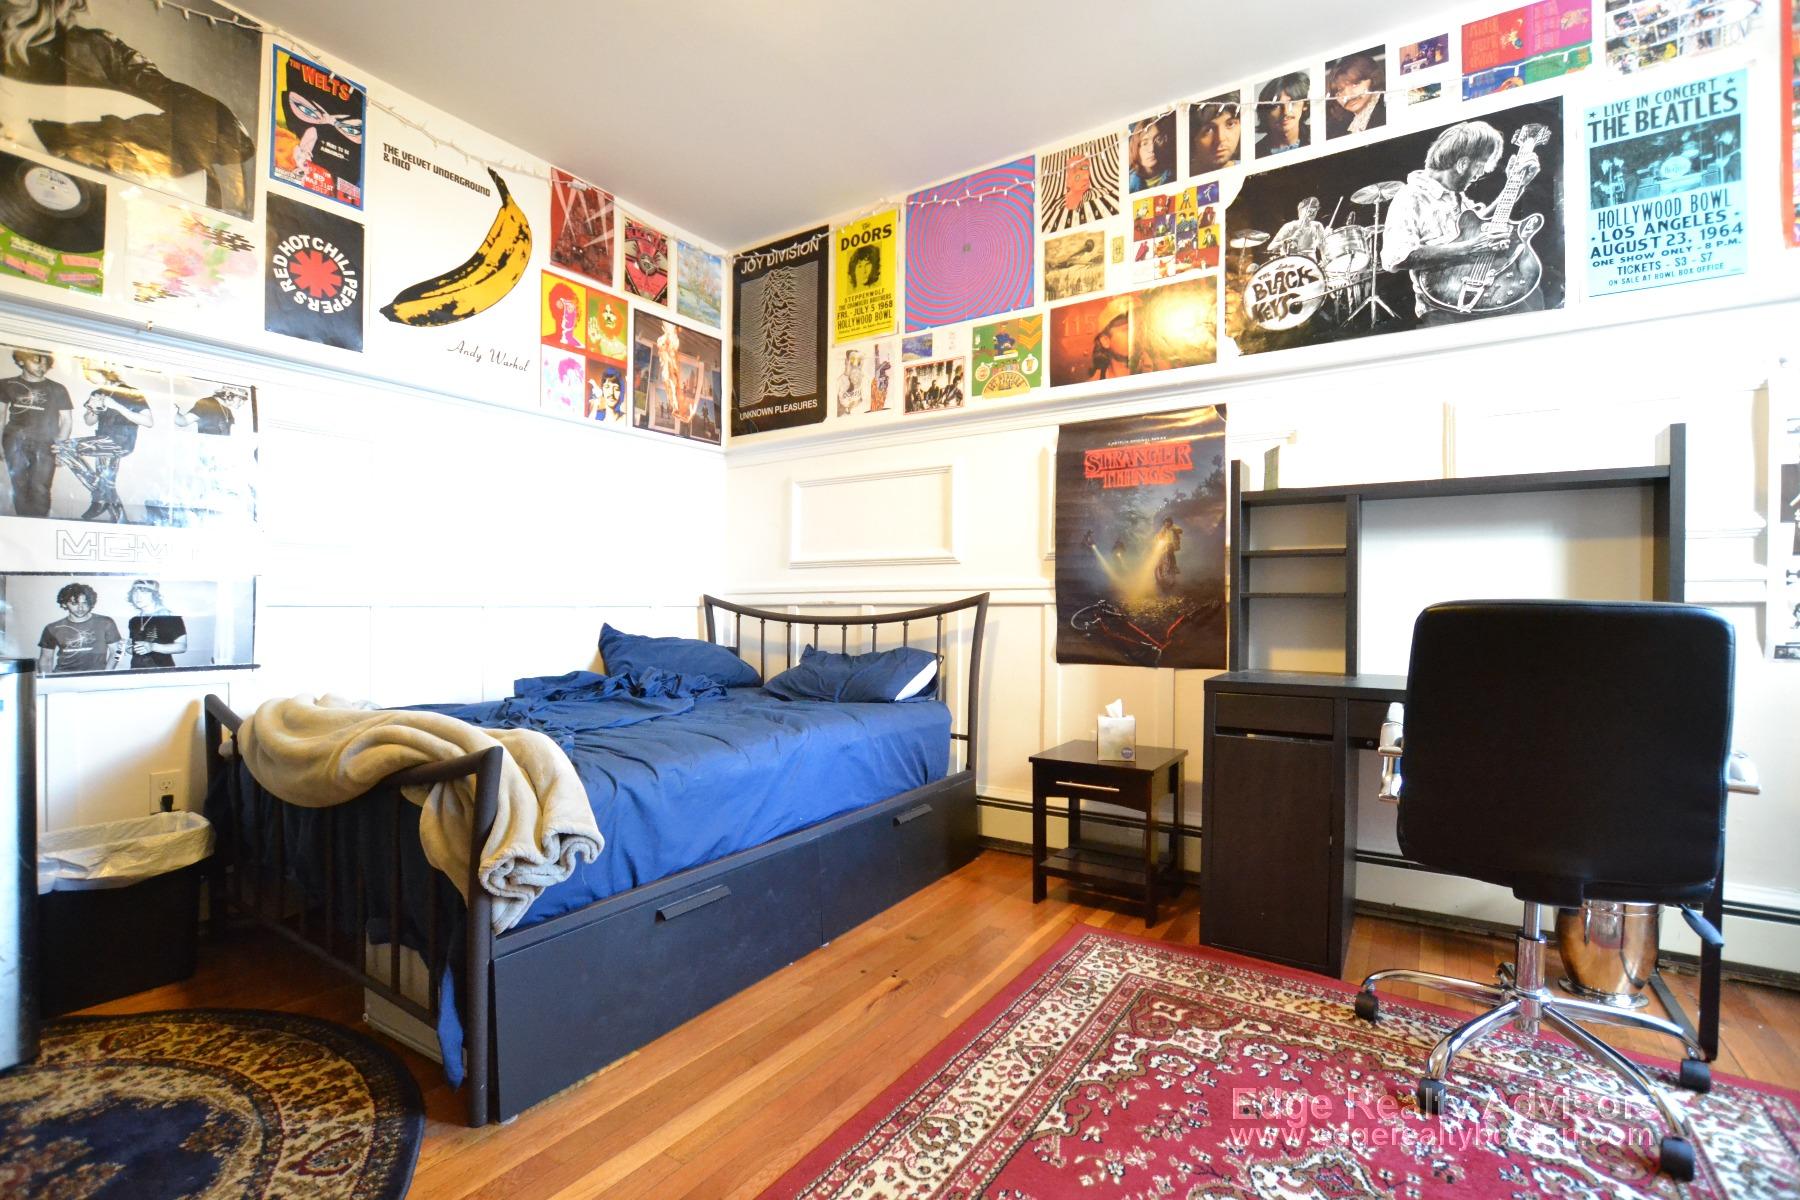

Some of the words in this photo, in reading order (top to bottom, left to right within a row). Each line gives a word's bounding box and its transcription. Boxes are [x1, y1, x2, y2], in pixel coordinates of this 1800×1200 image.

[301, 63, 351, 101] WELTS
[1603, 99, 1631, 117] LIVE
[1636, 95, 1649, 109] IN
[1655, 78, 1717, 104] CONCERT
[1587, 113, 1630, 143] THE
[1634, 87, 1738, 133] BEATLES
[383, 152, 390, 162] &
[391, 156, 411, 171] NICO
[383, 142, 399, 157] THE
[401, 150, 431, 171] VELVET
[433, 164, 491, 197] UNDERGROUND
[1598, 197, 1682, 231] HOLLYWOOD
[1690, 188, 1732, 214] BOWL
[1601, 225, 1635, 243] LOS
[1644, 208, 1727, 235] ANGELES
[278, 234, 311, 257] HOT
[840, 224, 892, 251] DOORS
[1590, 236, 1664, 260] AUGUST
[1699, 221, 1744, 240] 1964
[273, 254, 297, 292] RED
[311, 237, 356, 276] CHILI
[741, 257, 764, 275] JOY
[766, 239, 820, 267] DIVISION
[1592, 258, 1614, 268] ONE
[1620, 252, 1655, 264] SHOW
[1661, 245, 1692, 257] ONLY
[1617, 261, 1662, 276] TICKETS
[1252, 265, 1319, 301] BLACK
[1608, 279, 1618, 287] ON
[1621, 274, 1640, 285] SALE
[1642, 273, 1651, 281] AT
[1654, 270, 1676, 280] BOWL
[1678, 267, 1694, 276] BOX
[1697, 262, 1725, 273] OFFICE
[293, 277, 358, 314] PEPPERS
[853, 304, 869, 317] JULY
[871, 303, 875, 312] 5
[878, 300, 893, 311] 1968
[1251, 292, 1301, 322] KEYS
[837, 314, 873, 330] HOLLYWOOD
[874, 309, 892, 322] BOWL
[447, 340, 482, 363] Andy
[489, 348, 530, 372] Warhol
[739, 405, 774, 421] UNKNOWN
[774, 398, 818, 413] PLEASURES
[1085, 441, 1193, 478] STRANGER
[1103, 469, 1176, 488] THINGS
